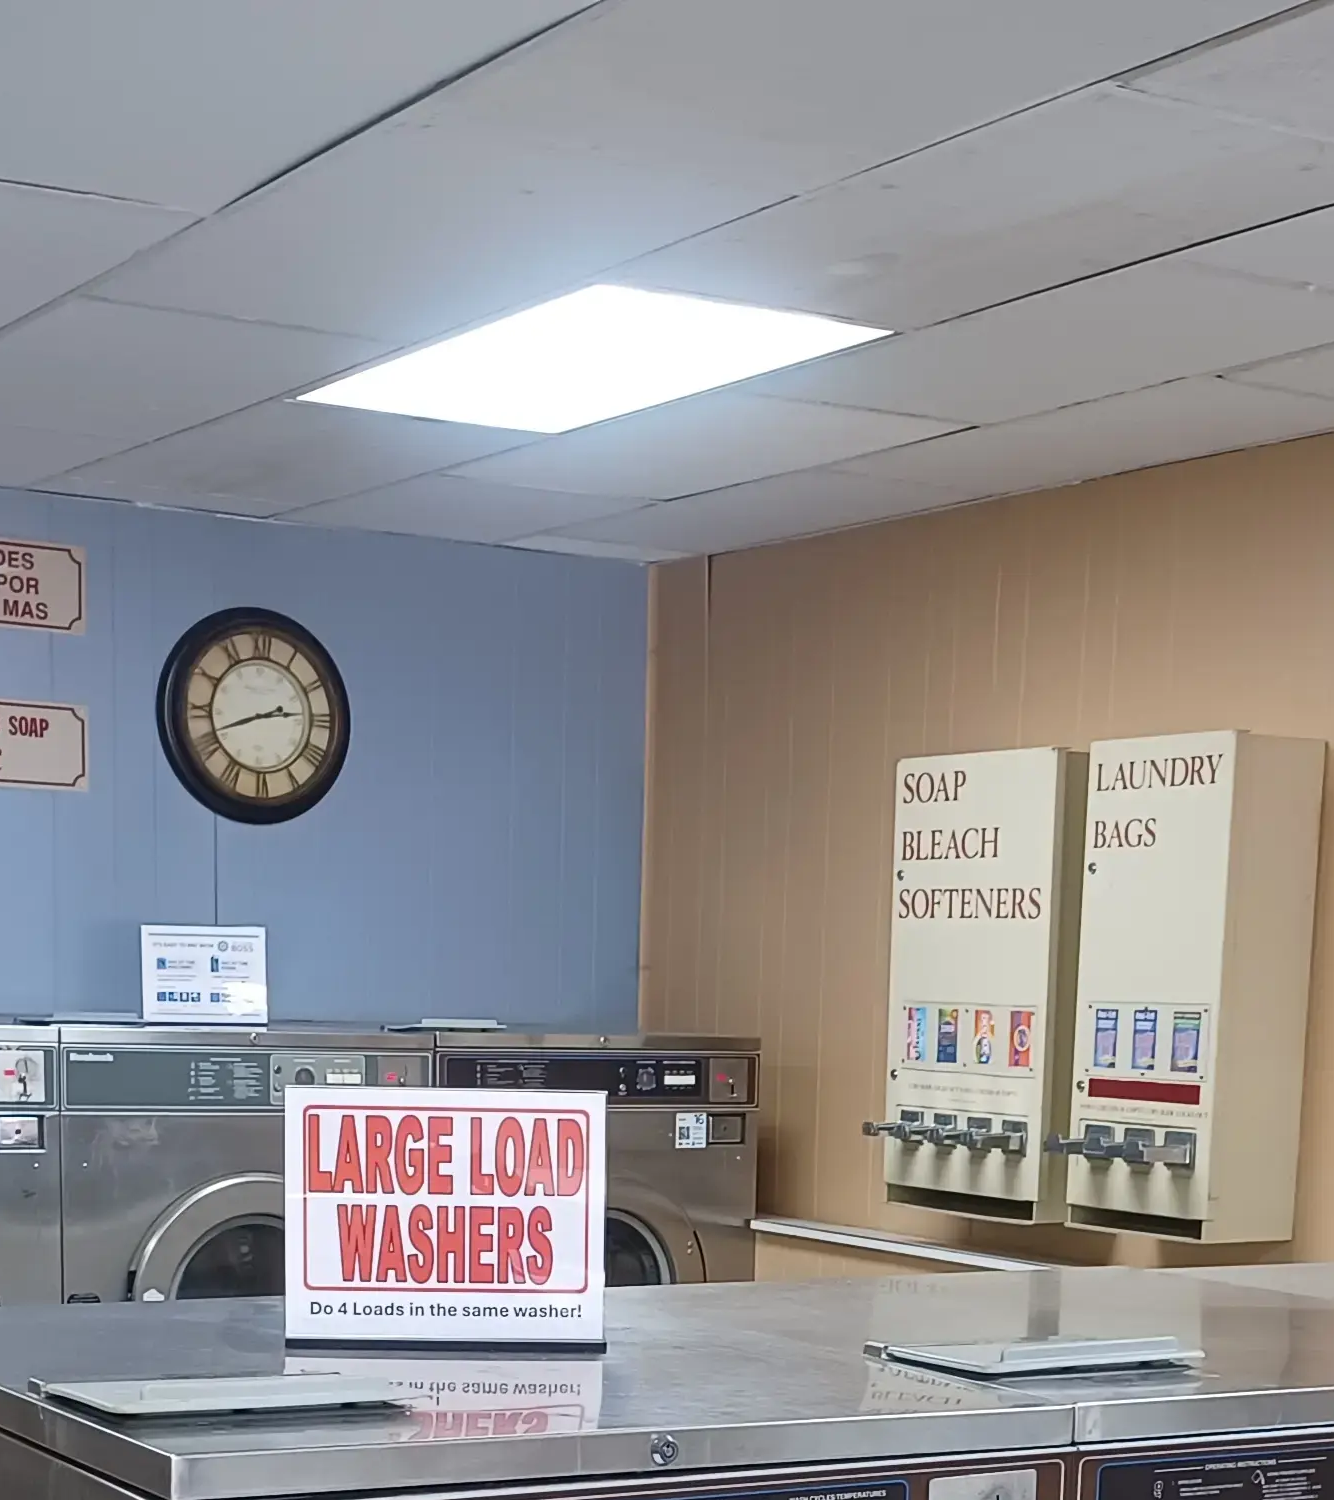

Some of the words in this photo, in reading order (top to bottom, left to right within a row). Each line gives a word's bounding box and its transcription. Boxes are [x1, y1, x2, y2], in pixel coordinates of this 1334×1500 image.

[2, 600, 49, 621] MAS
[7, 715, 50, 739] SOAP
[902, 770, 967, 804] SOAP
[1096, 754, 1224, 792] LAUNDRY
[901, 827, 1001, 861] BLEACH
[1093, 818, 1157, 849] BAGS
[898, 886, 1042, 920] SOFTENERS
[308, 1114, 453, 1195] LARGE
[470, 1116, 584, 1197] LOAD
[336, 1204, 554, 1285] WASHERS
[310, 1301, 334, 1316] Do
[337, 1301, 348, 1316] 4
[353, 1301, 405, 1317] Loads
[410, 1302, 425, 1316] in
[429, 1302, 457, 1317] the
[462, 1305, 509, 1318] same
[514, 1304, 582, 1319] washer!
